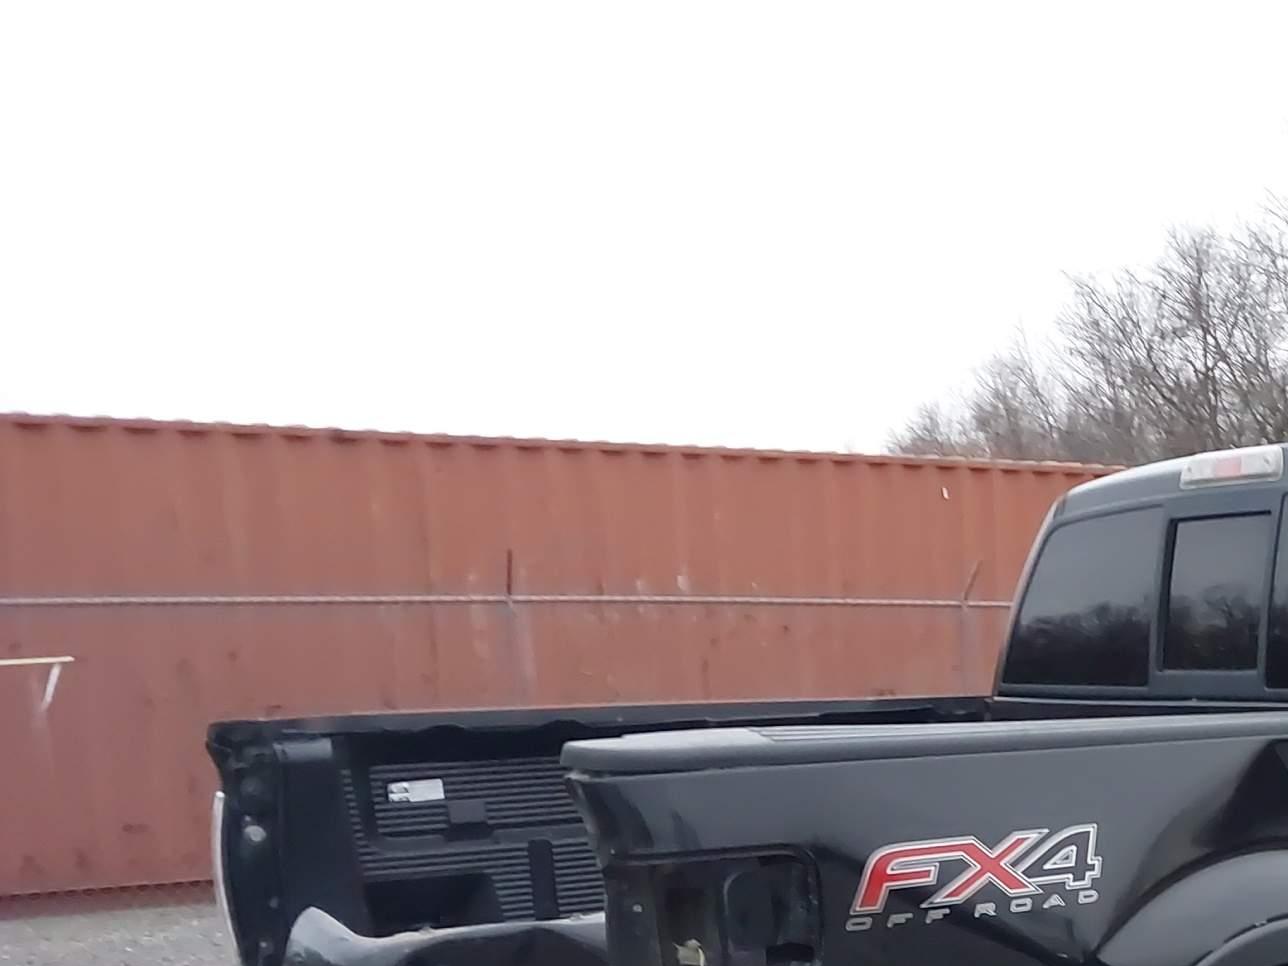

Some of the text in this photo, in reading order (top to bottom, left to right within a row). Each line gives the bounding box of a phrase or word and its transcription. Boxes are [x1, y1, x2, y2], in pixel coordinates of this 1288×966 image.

[850, 823, 1103, 915] FX4
[845, 890, 1099, 932] OFF ROAD
